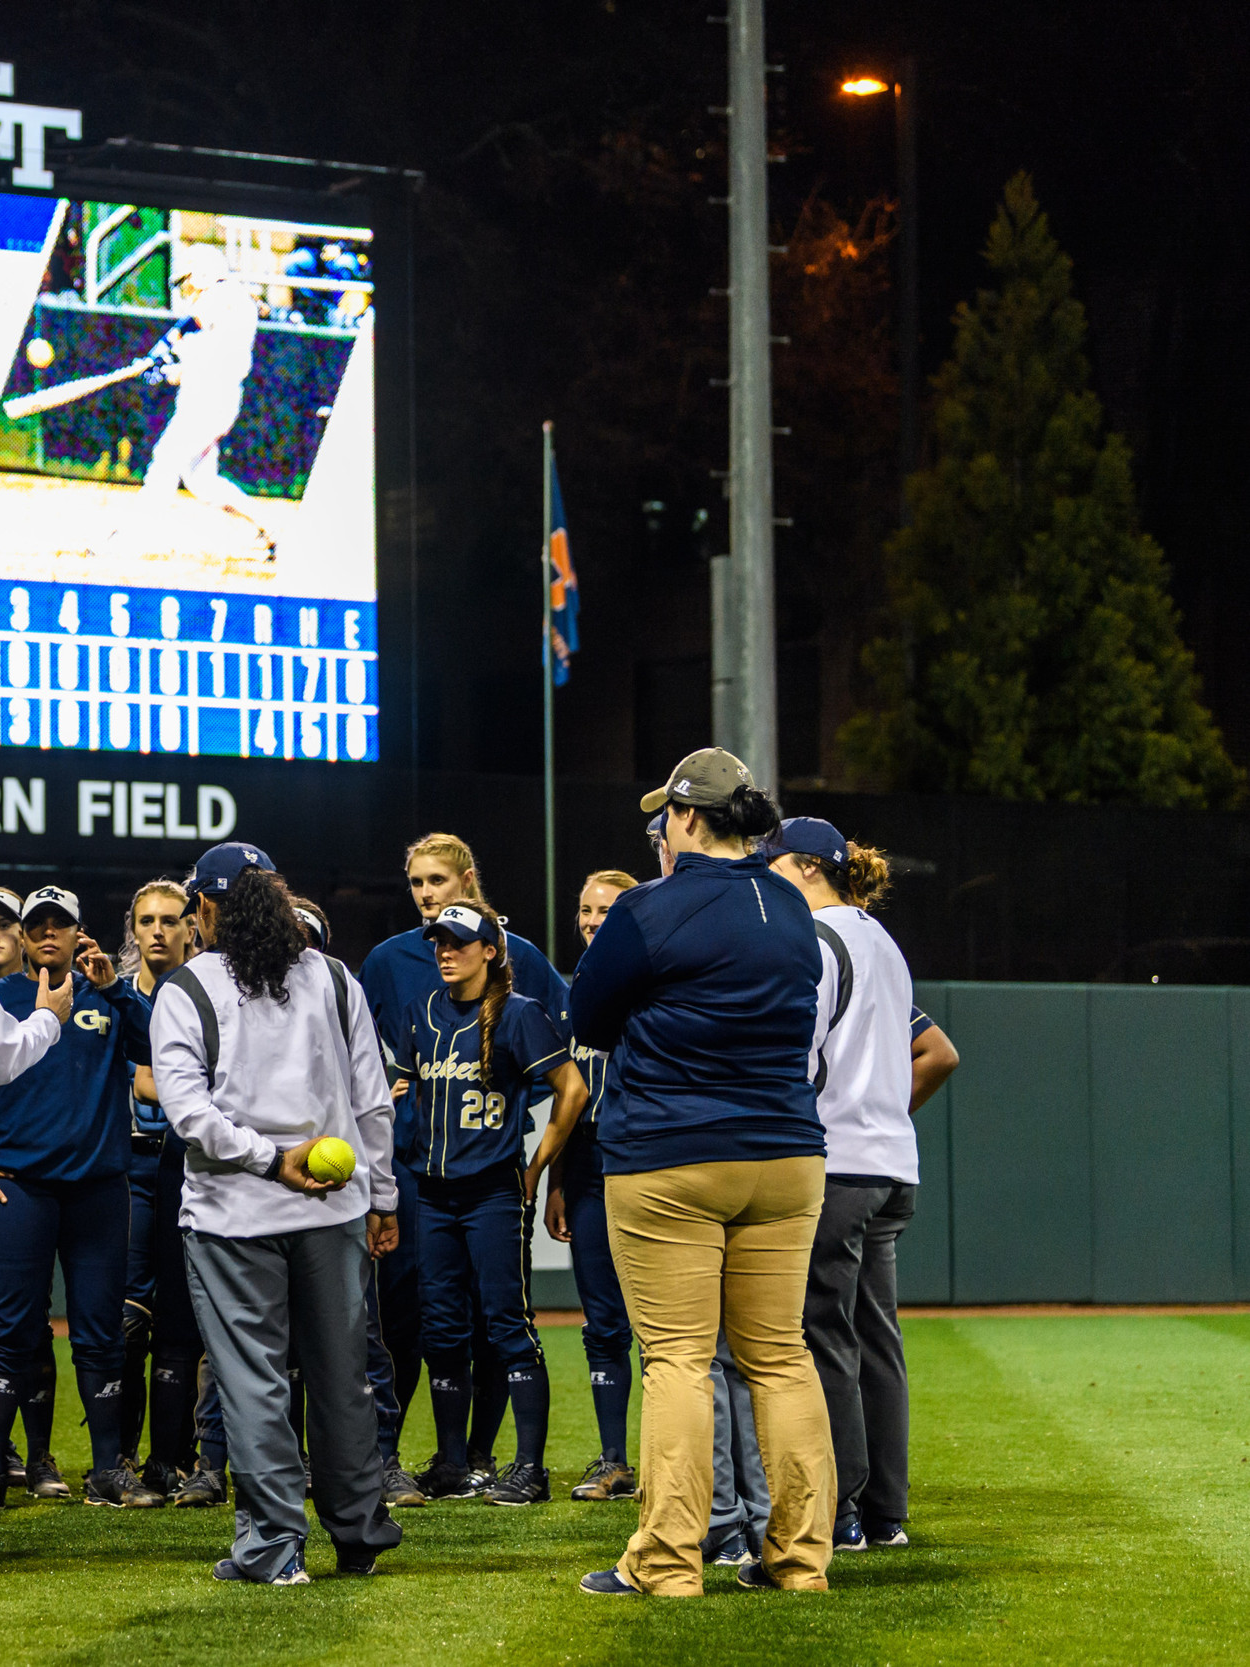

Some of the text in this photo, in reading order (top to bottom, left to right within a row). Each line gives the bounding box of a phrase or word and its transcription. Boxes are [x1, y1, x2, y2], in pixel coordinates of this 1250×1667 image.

[10, 587, 29, 632] 3
[59, 590, 80, 634] 4
[110, 593, 130, 637] 5
[210, 599, 227, 642] 7
[300, 607, 318, 647] H
[345, 610, 360, 649] E
[210, 652, 225, 698] 1
[258, 654, 272, 700] 1
[301, 656, 320, 702] 7
[8, 697, 30, 745] 3
[254, 708, 277, 755] 4
[301, 711, 321, 757] 5
[78, 780, 237, 840] FIELD
[35, 888, 65, 900] GT
[444, 908, 464, 919] GT
[73, 1009, 111, 1035] GT
[415, 1051, 493, 1082] acket
[460, 1090, 506, 1130] 28
